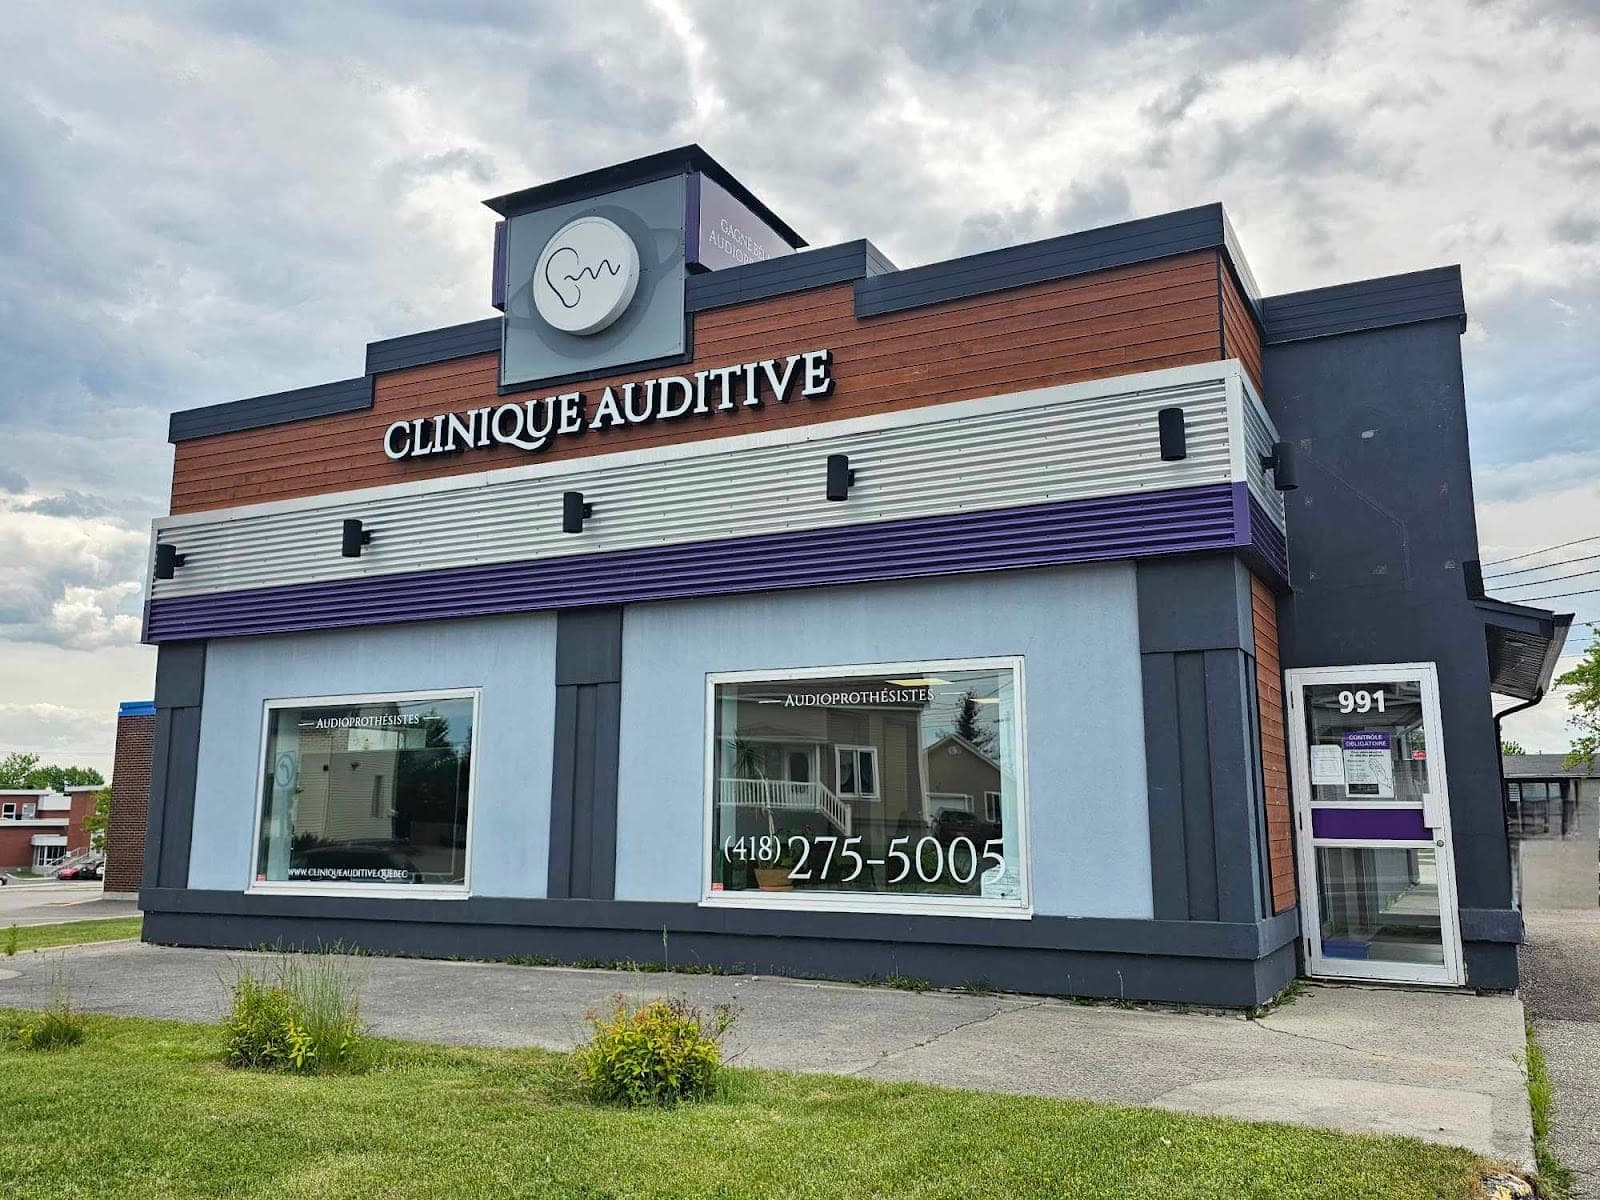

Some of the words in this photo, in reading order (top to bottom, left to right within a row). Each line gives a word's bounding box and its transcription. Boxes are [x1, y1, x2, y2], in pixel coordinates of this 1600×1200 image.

[383, 391, 584, 460] CLINIQUE
[588, 348, 832, 430] AUDITIVE
[784, 687, 935, 707] AUDIOPROTHÉSISTES
[1338, 689, 1386, 714] 991
[316, 713, 420, 729] AUDIOPROTHÉSISTES
[723, 834, 782, 865] (418)
[787, 835, 1007, 885] 275-5005
